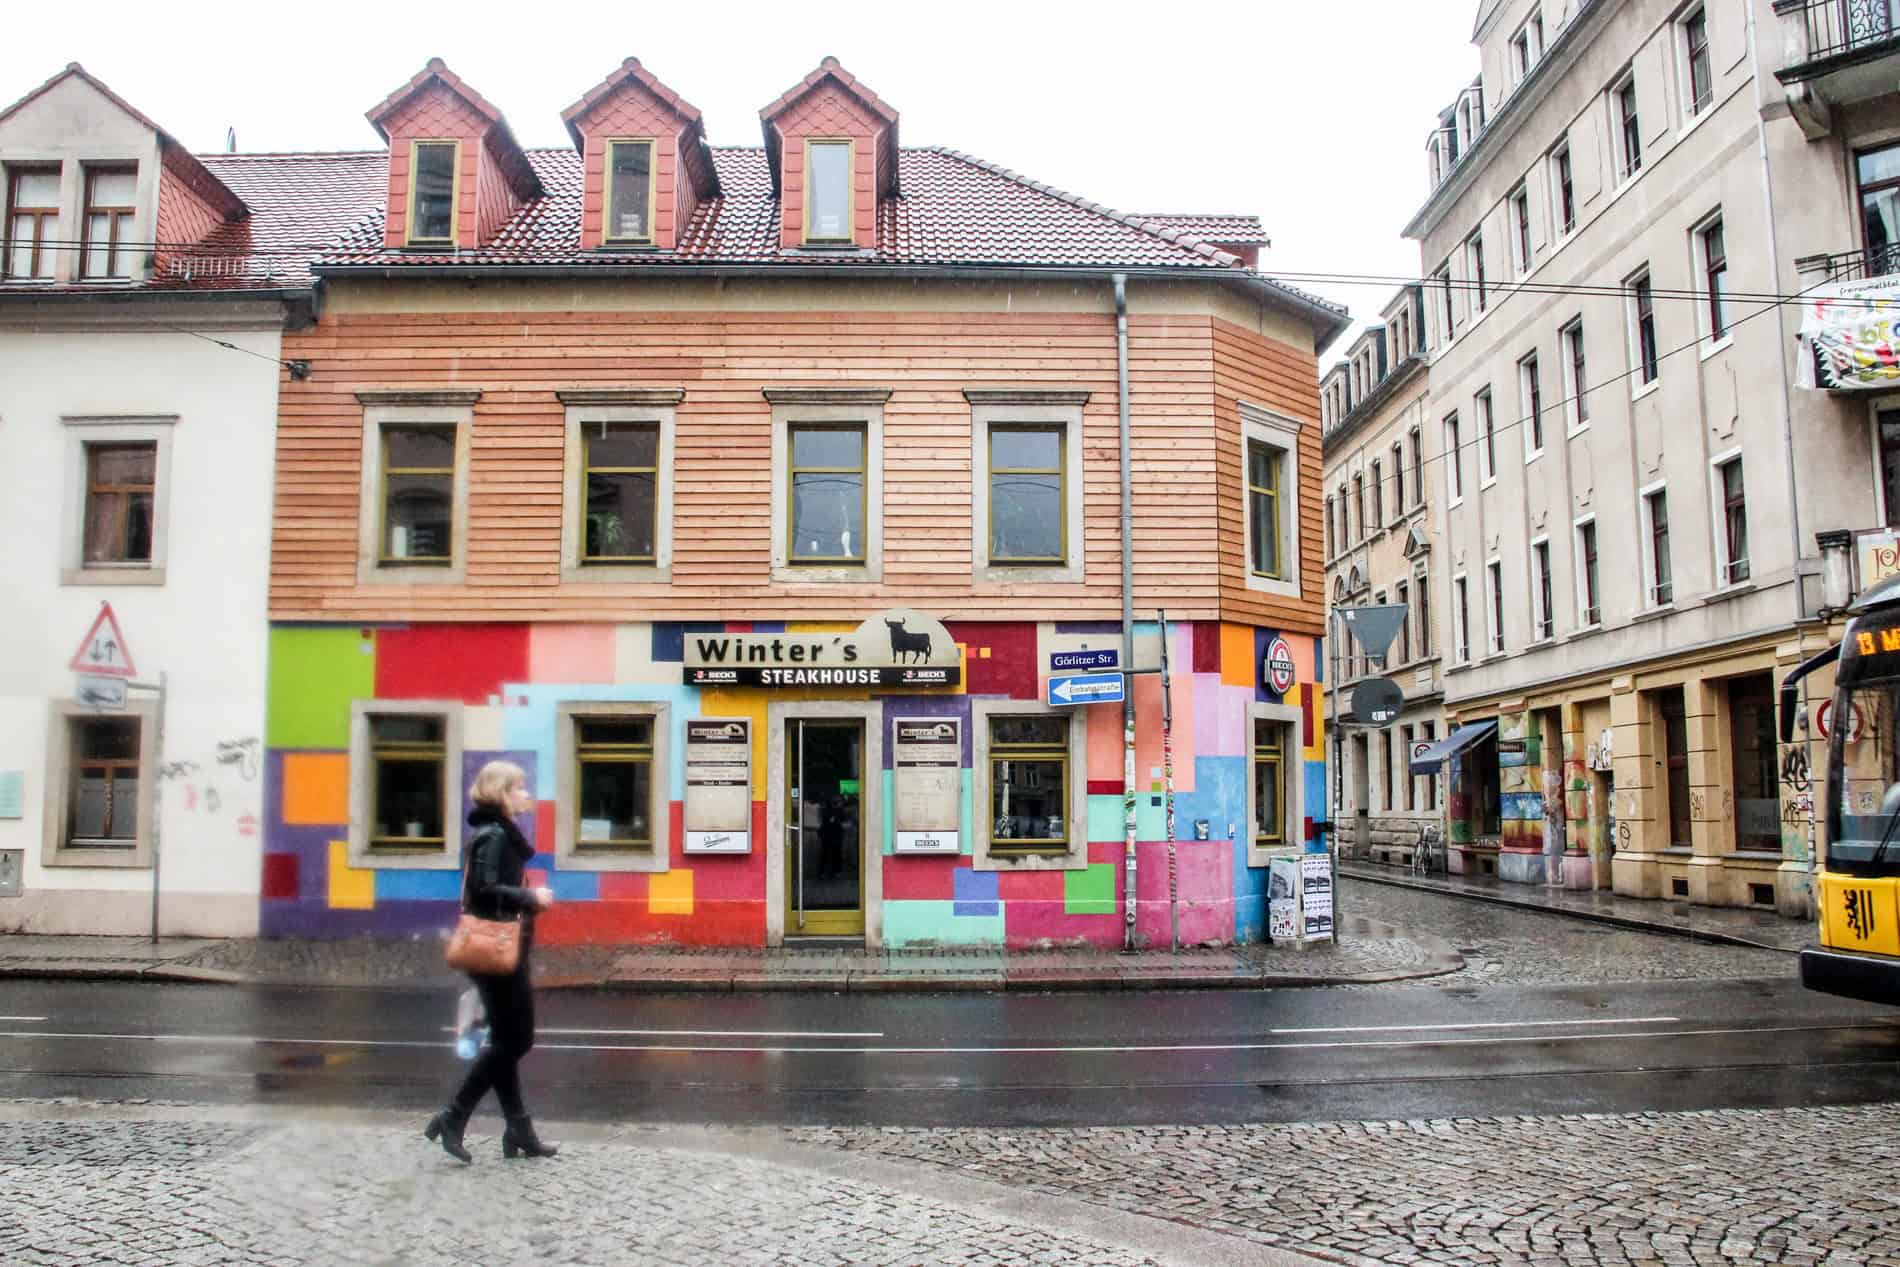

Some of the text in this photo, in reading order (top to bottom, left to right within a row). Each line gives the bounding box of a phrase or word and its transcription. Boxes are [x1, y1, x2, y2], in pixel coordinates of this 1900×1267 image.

[1054, 654, 1114, 667] Görlitzer Str.
[761, 669, 881, 684] STEAKHOUSE
